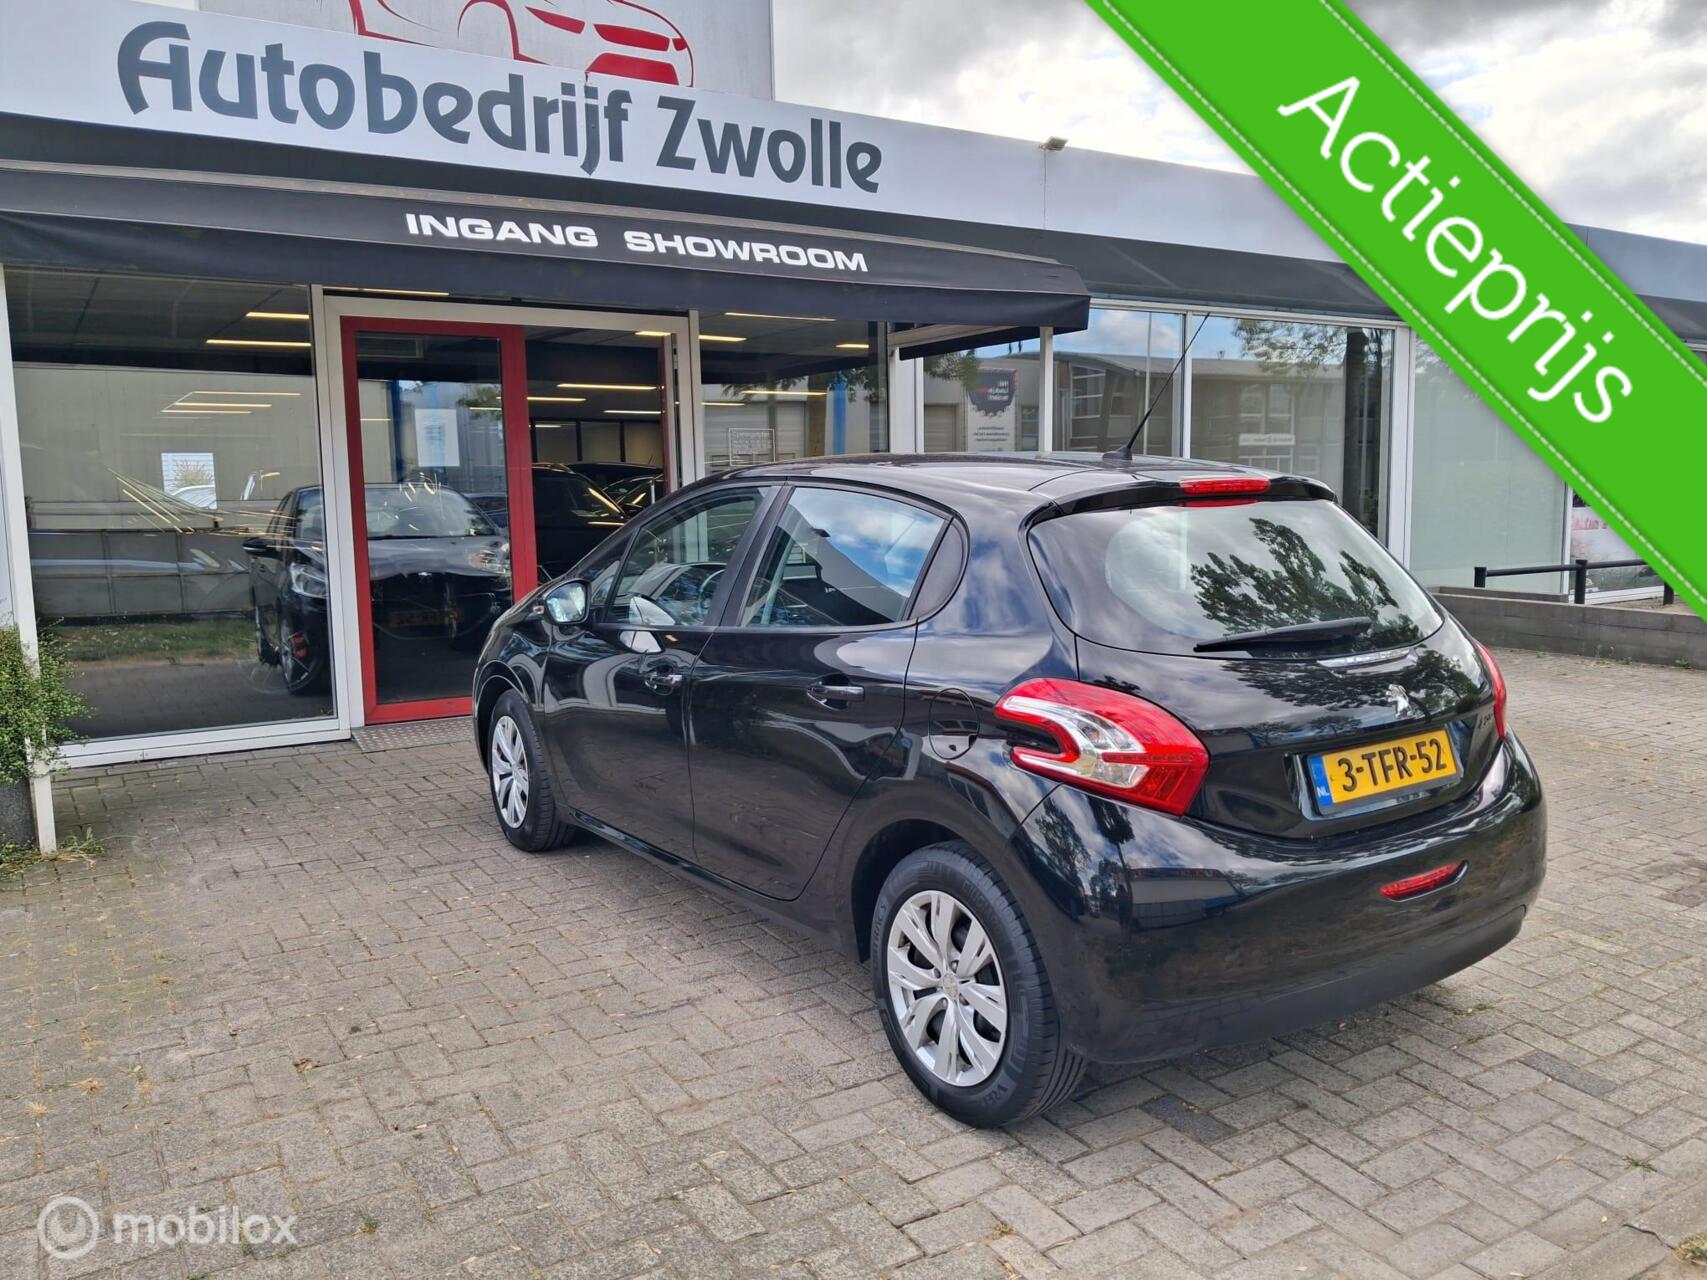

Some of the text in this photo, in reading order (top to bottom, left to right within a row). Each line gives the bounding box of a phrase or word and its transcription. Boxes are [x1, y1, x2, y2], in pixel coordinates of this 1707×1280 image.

[117, 20, 883, 194] Autobedrijf Zwolle
[406, 213, 869, 273] INGANG SHOWROOM
[1316, 786, 1331, 798] NL
[1337, 738, 1448, 793] 3-TFR-52
